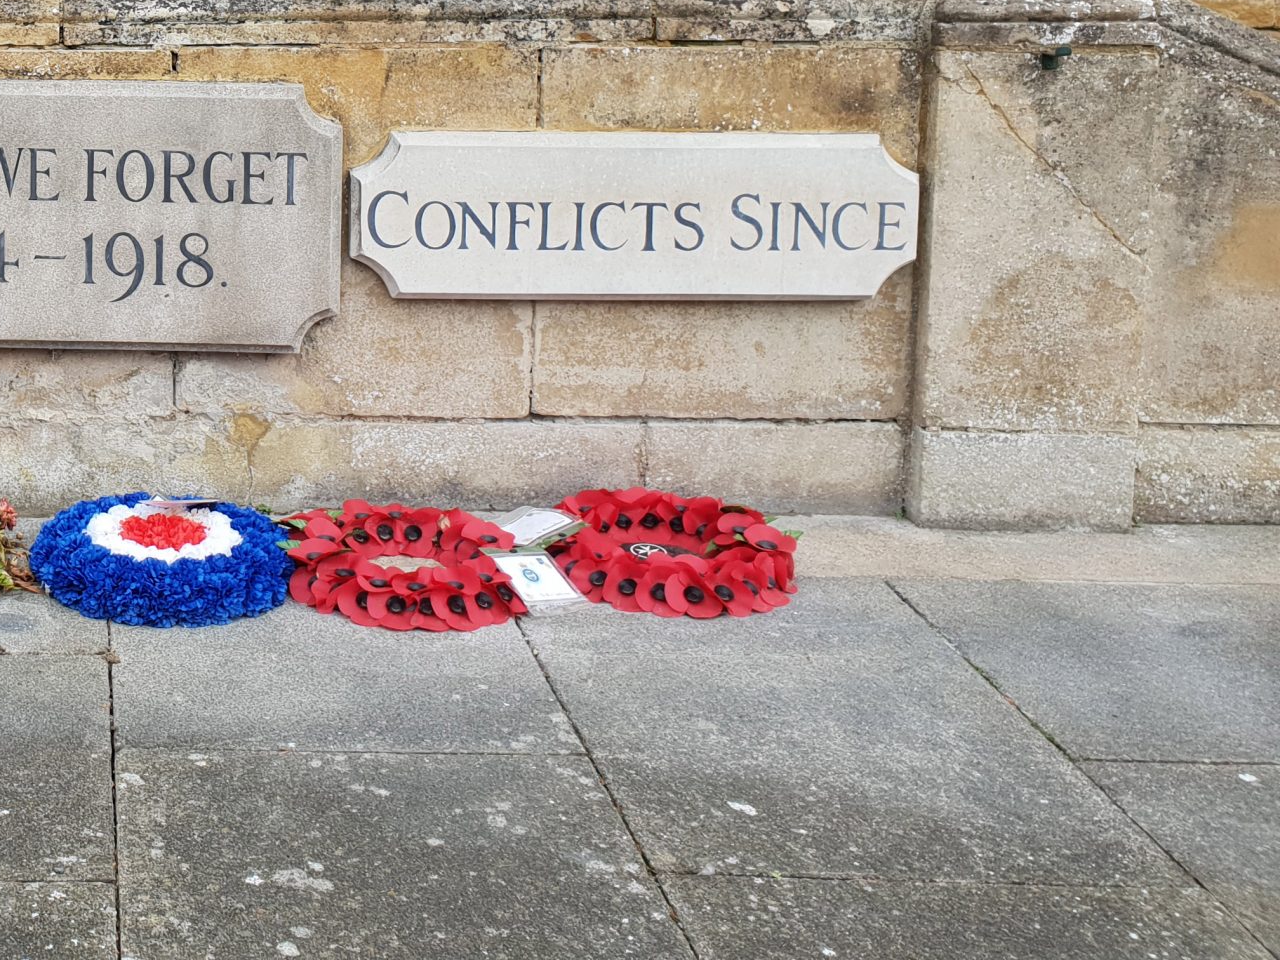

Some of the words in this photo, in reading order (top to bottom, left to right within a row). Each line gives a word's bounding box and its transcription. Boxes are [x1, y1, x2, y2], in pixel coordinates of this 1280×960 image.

[83, 148, 309, 206] FORGET
[367, 189, 706, 252] CONFLICTS
[729, 192, 910, 252] SINCE
